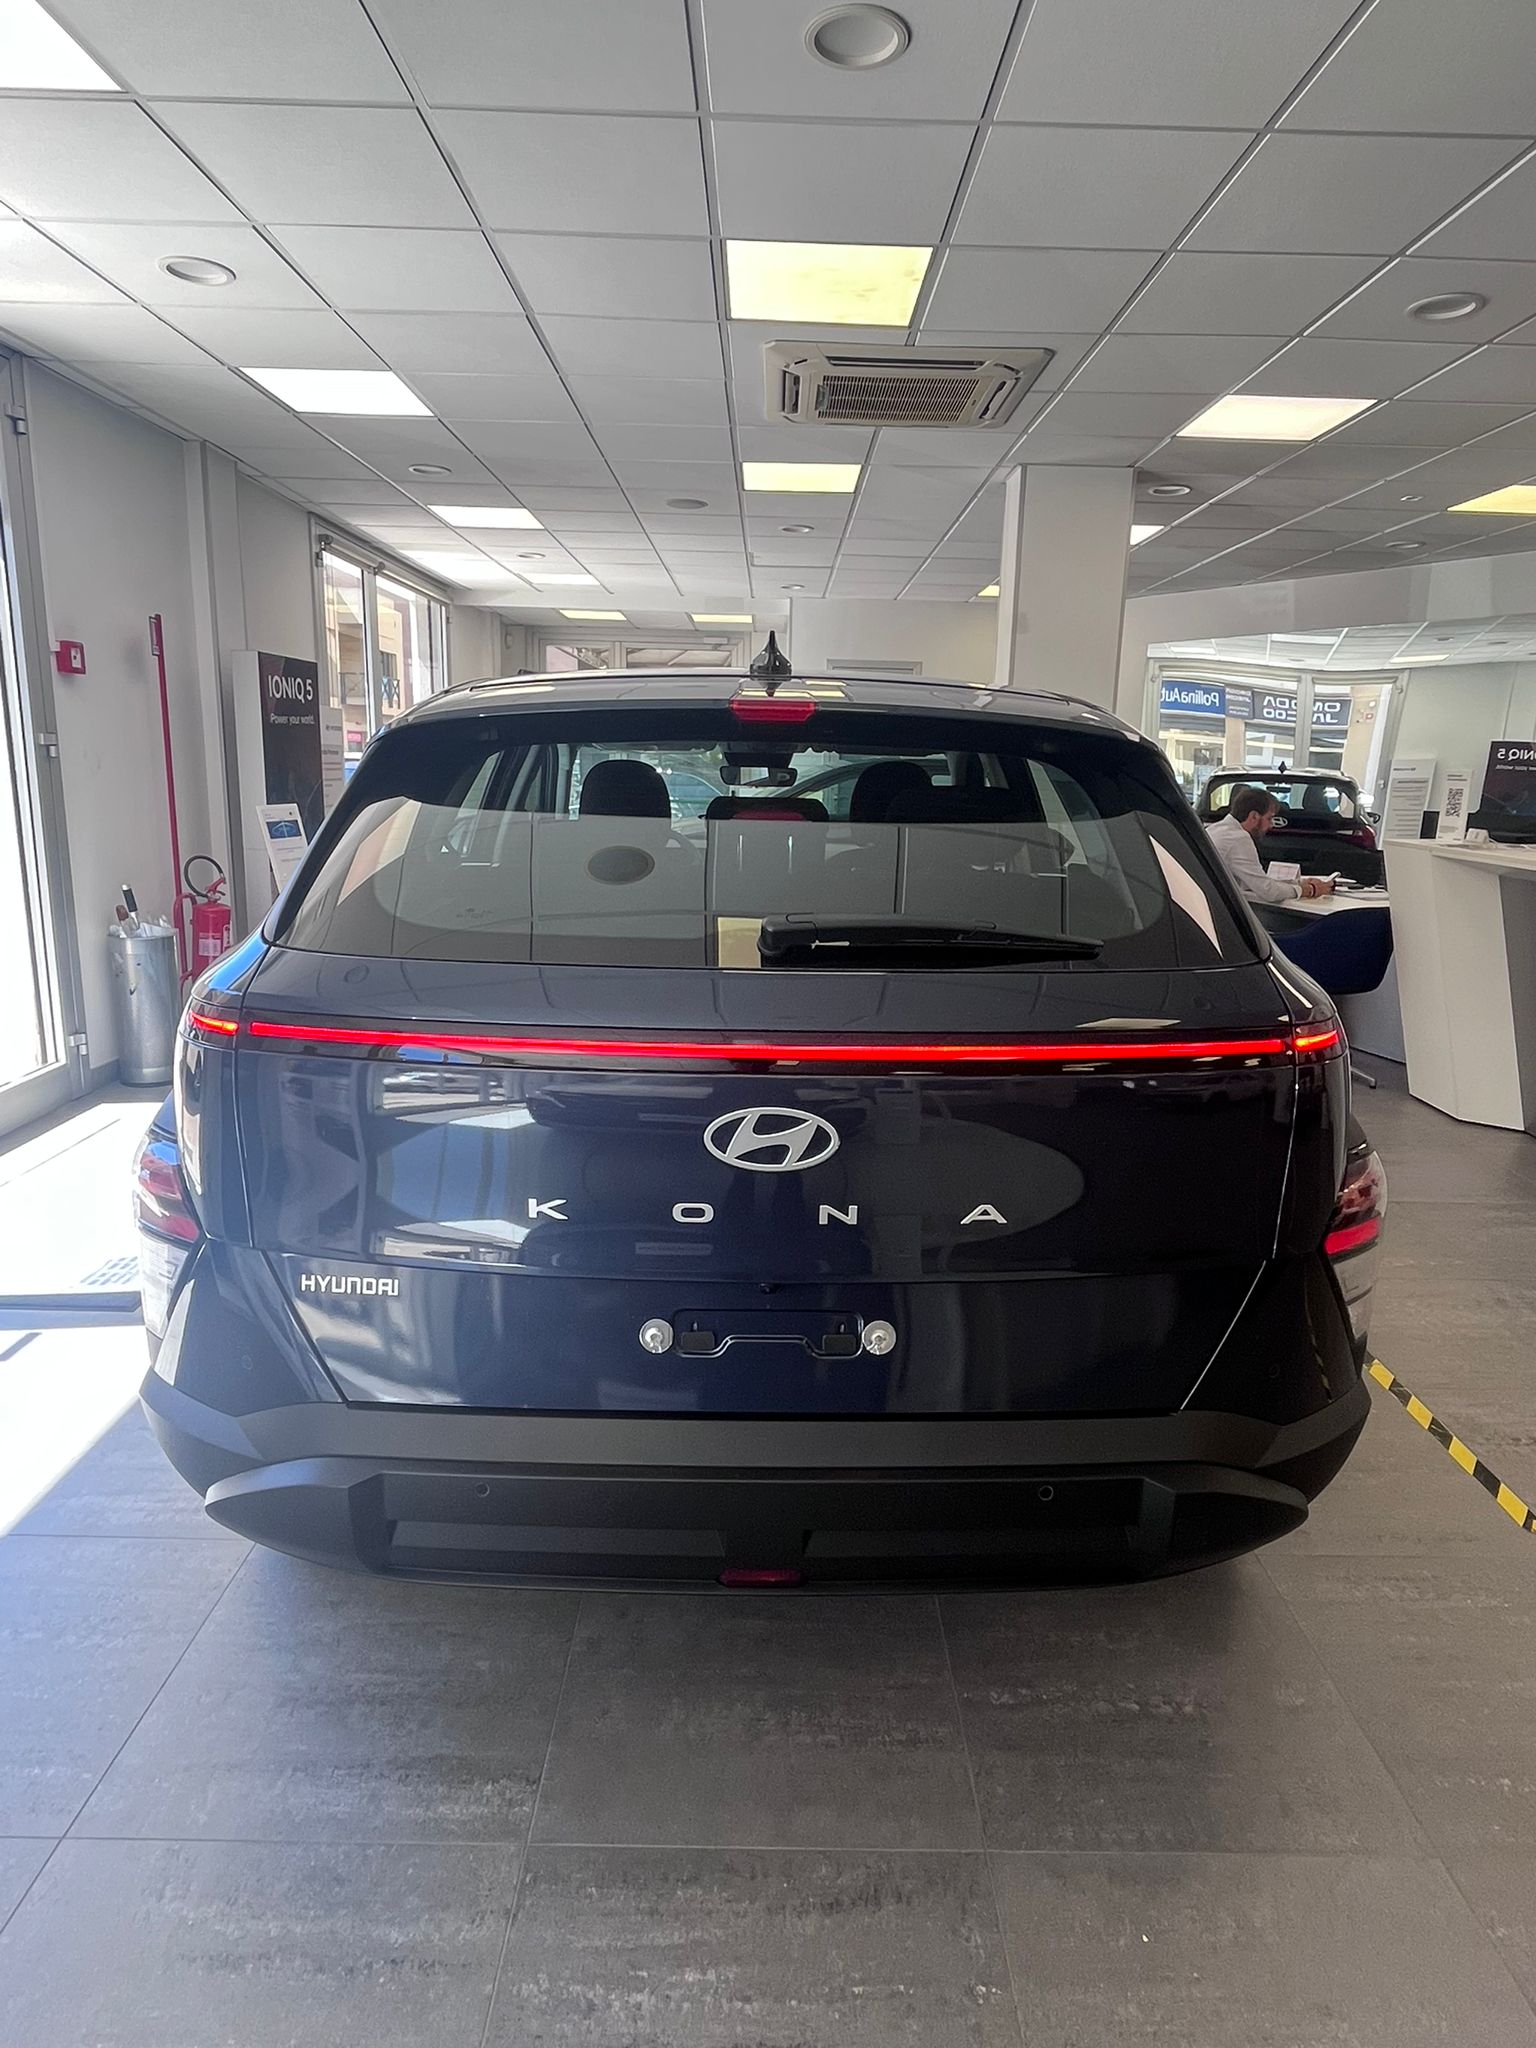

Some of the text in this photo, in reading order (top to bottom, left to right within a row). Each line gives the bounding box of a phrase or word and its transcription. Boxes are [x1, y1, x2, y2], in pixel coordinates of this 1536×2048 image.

[268, 674, 314, 703] IONIQ 5
[301, 1273, 399, 1296] HYUNDAI
